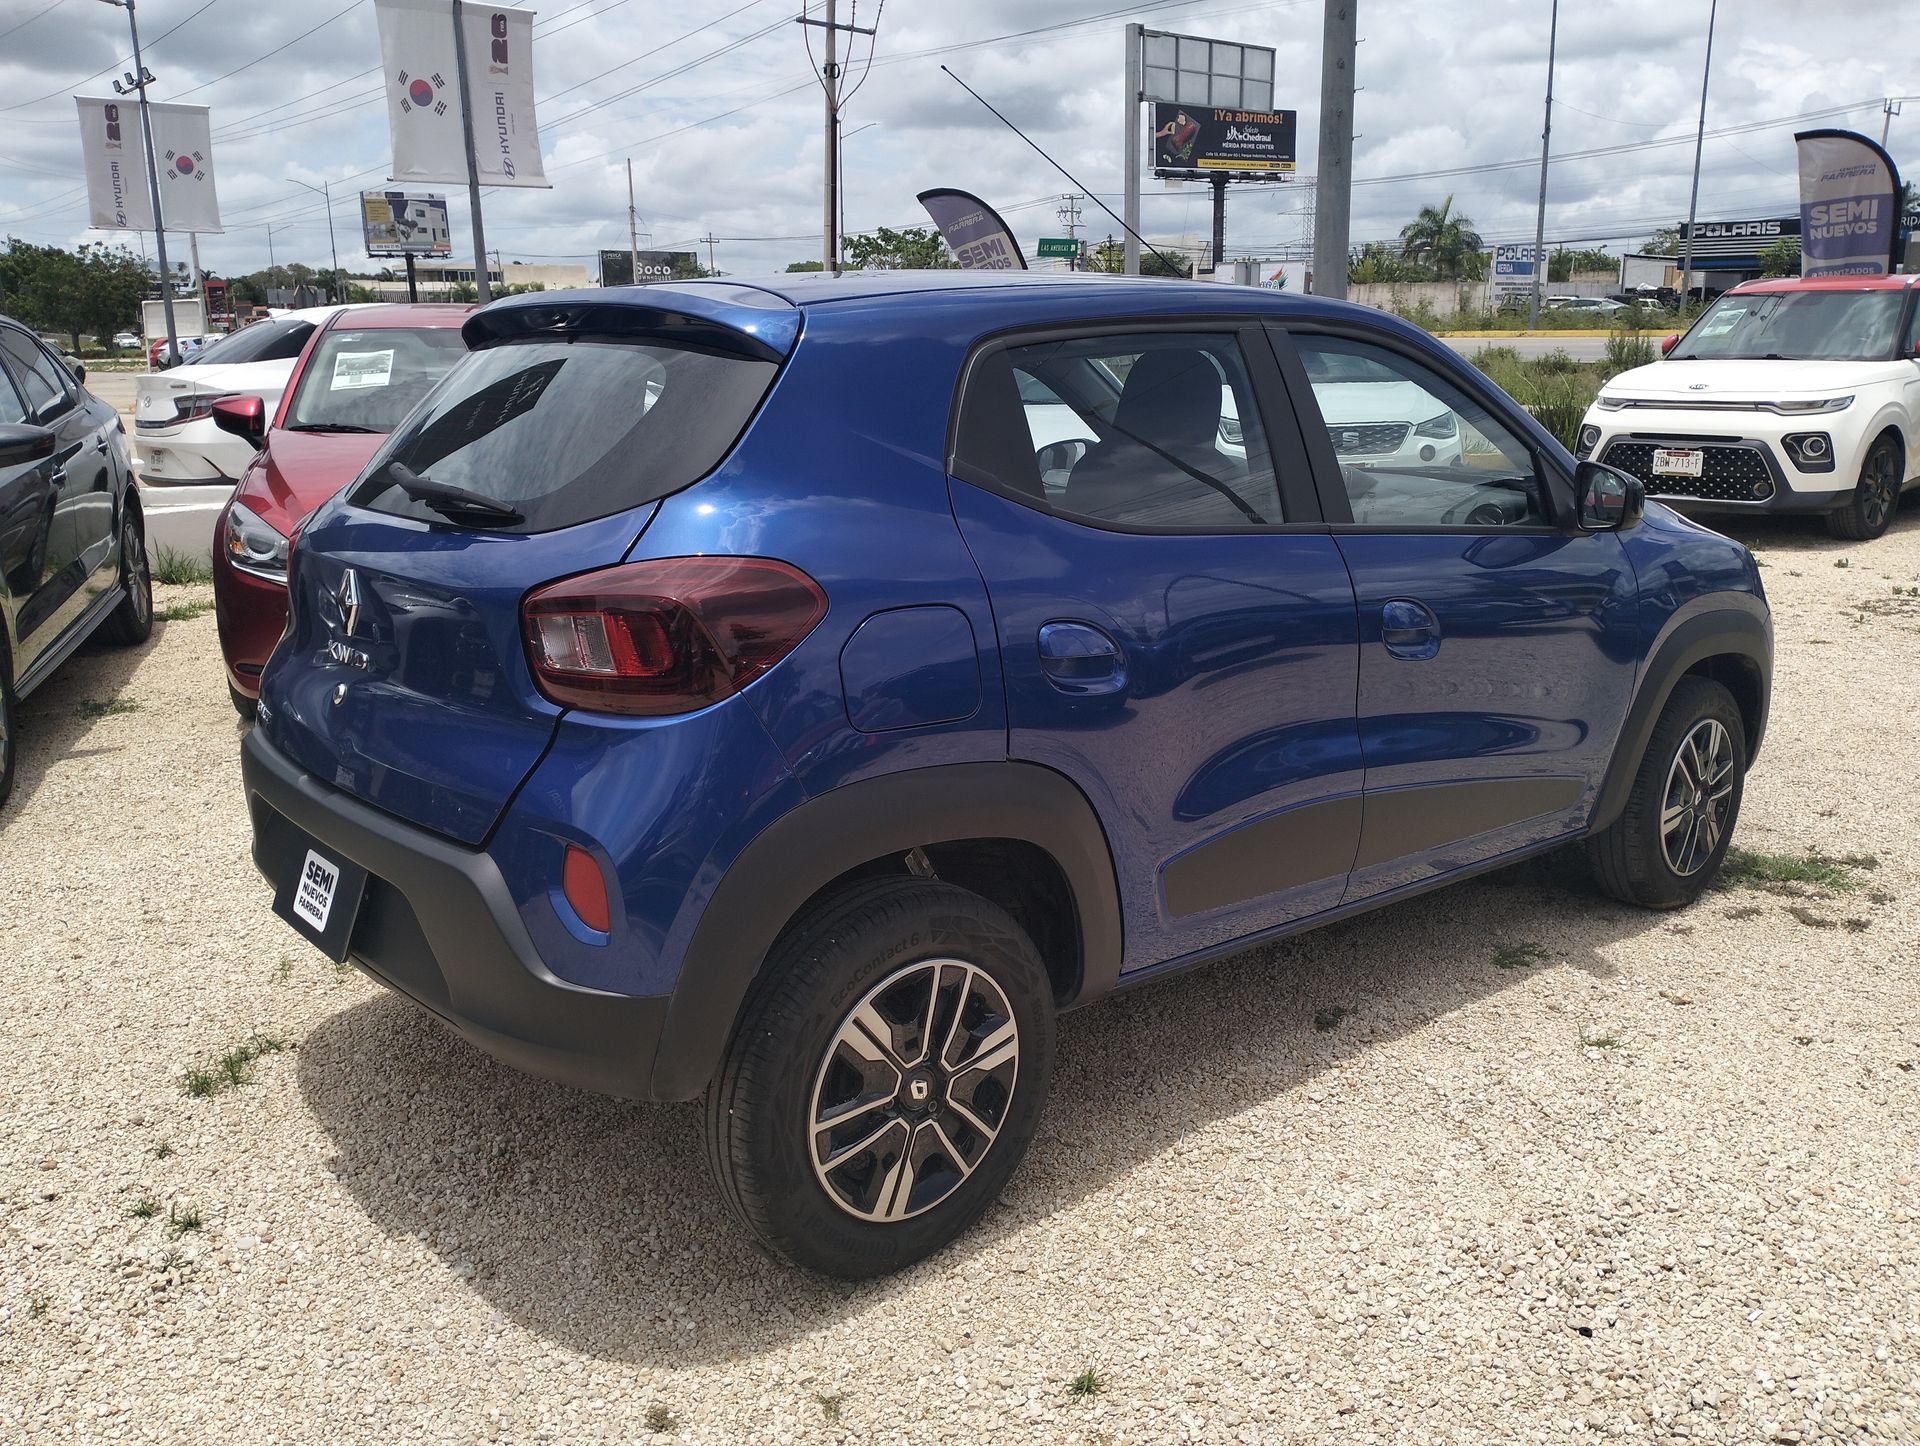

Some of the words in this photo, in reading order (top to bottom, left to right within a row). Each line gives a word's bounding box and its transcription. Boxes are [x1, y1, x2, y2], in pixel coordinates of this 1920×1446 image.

[495, 92, 511, 154] HYUNDAI
[111, 161, 123, 208] HYUNDAI
[1820, 168, 1876, 182] FARRERA
[1810, 199, 1879, 226] SEMI
[1693, 221, 1781, 237] POLARIS
[1809, 222, 1878, 240] NUEVOS
[957, 238, 1007, 269] SEMI
[1497, 247, 1547, 262] POLARS
[306, 860, 335, 895] SEMI
[302, 881, 328, 908] NUEVOS
[298, 895, 323, 922] FARRERA
[831, 937, 907, 1009] EcoContact
[910, 931, 921, 947] 6
